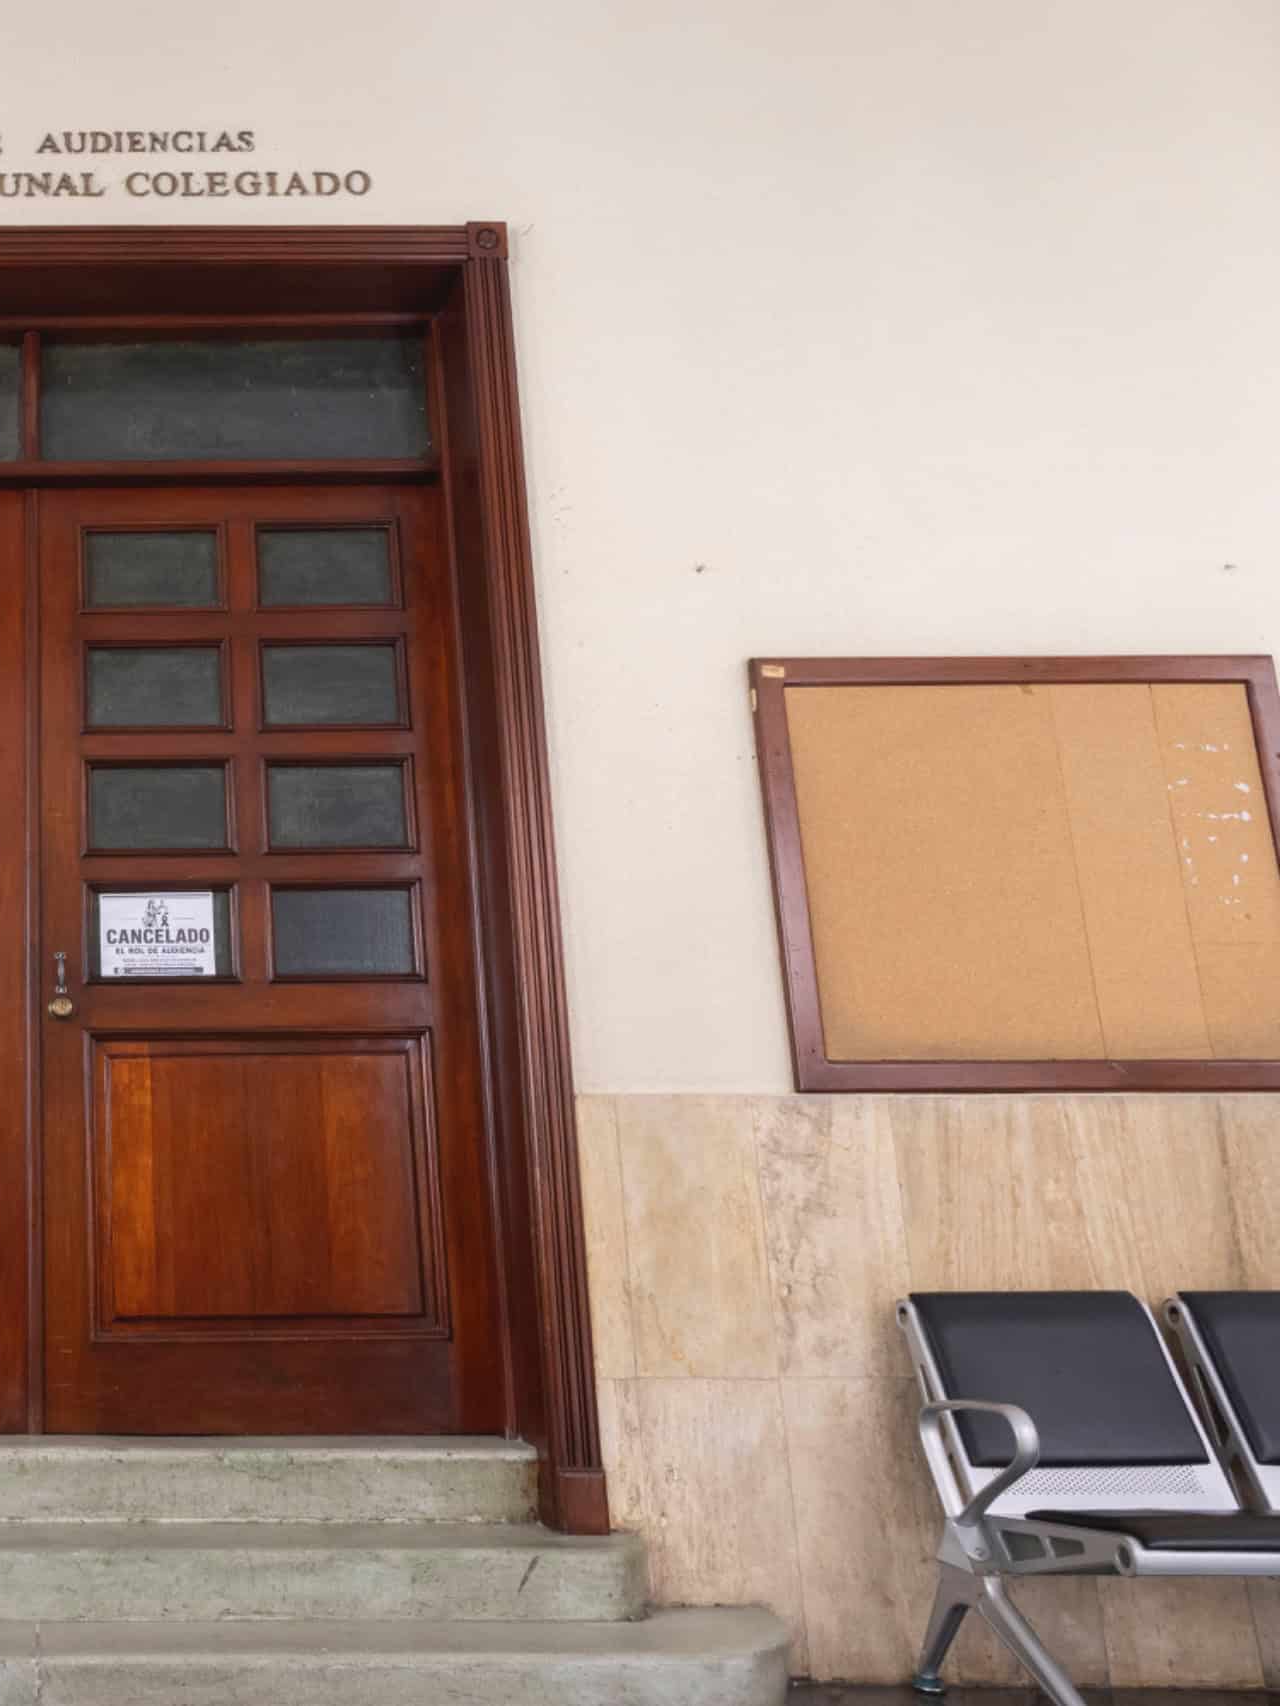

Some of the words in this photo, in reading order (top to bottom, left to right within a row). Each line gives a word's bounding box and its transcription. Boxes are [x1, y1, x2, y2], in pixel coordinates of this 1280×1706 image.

[36, 130, 256, 154] AUDIENCIAS
[125, 170, 371, 197] COLEGIADO
[106, 928, 210, 944] CANCELADO
